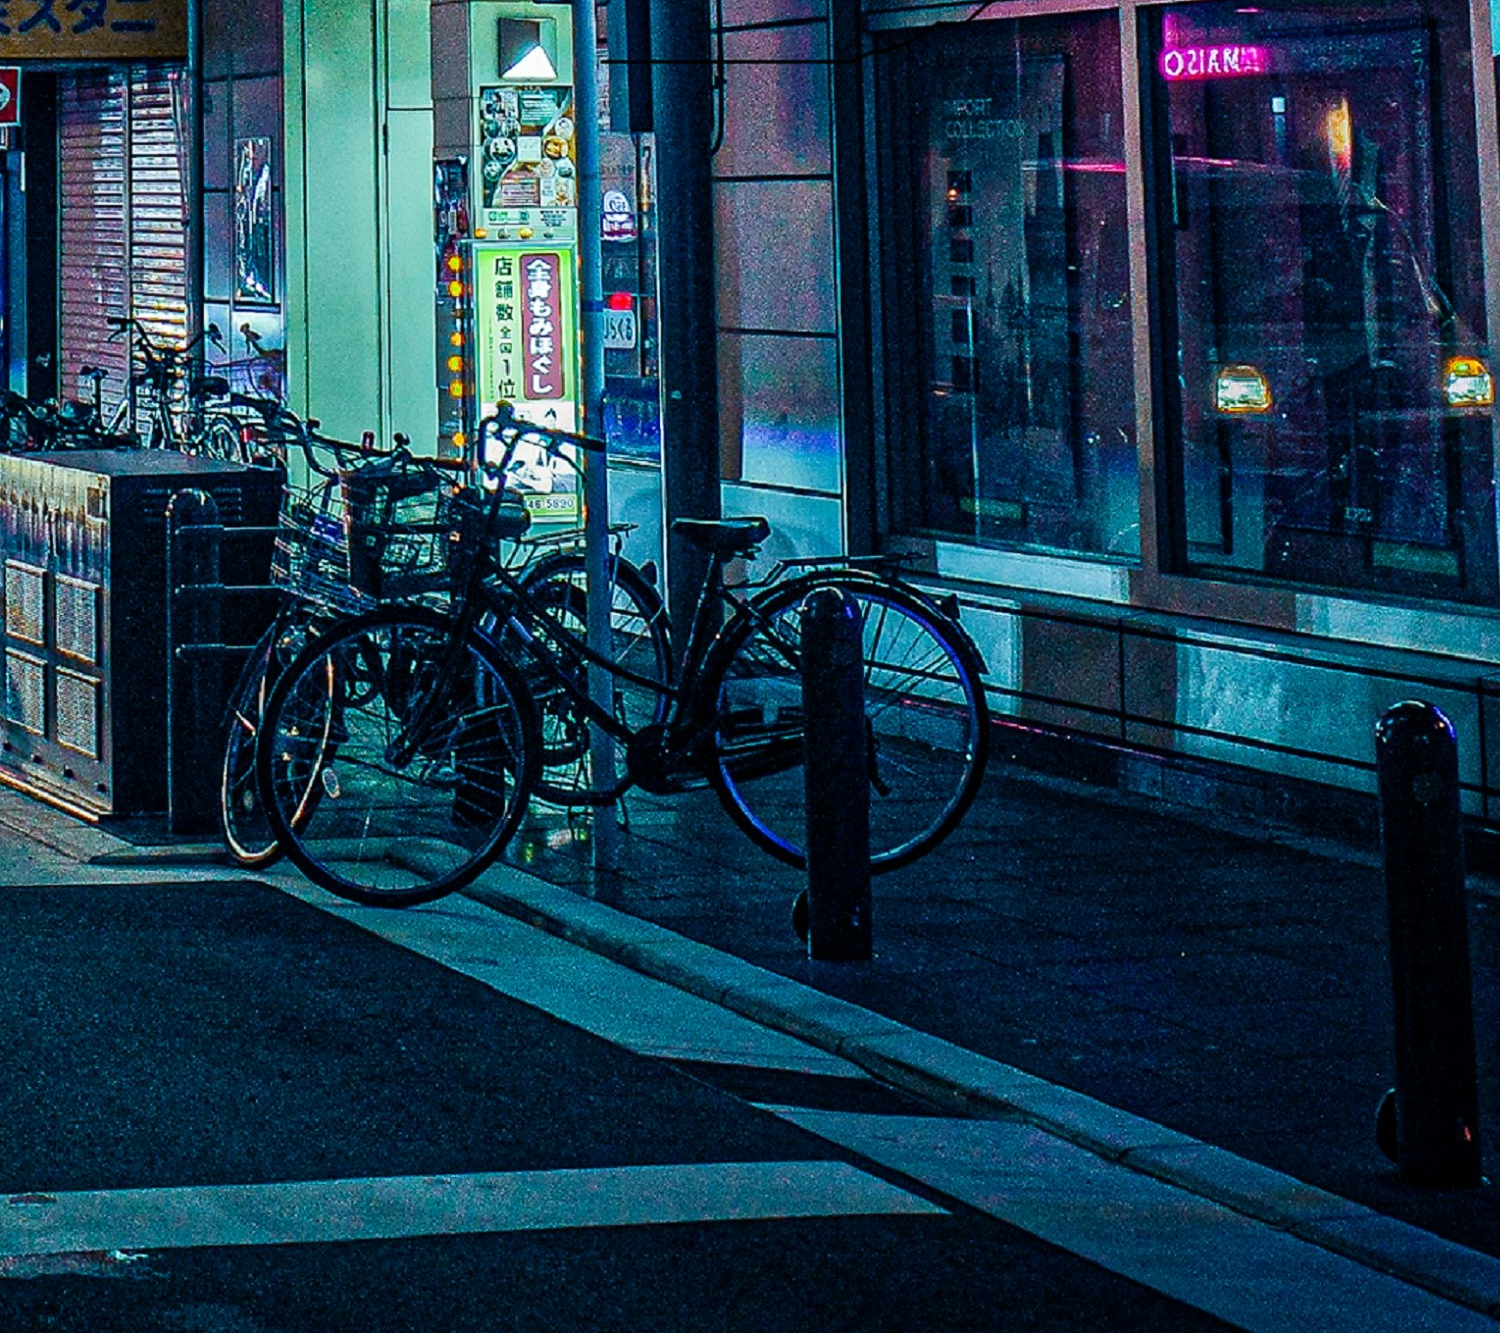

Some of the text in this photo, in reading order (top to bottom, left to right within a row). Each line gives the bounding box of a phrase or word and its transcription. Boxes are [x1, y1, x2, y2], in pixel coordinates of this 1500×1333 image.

[525, 258, 557, 396] 全身もみほぐし
